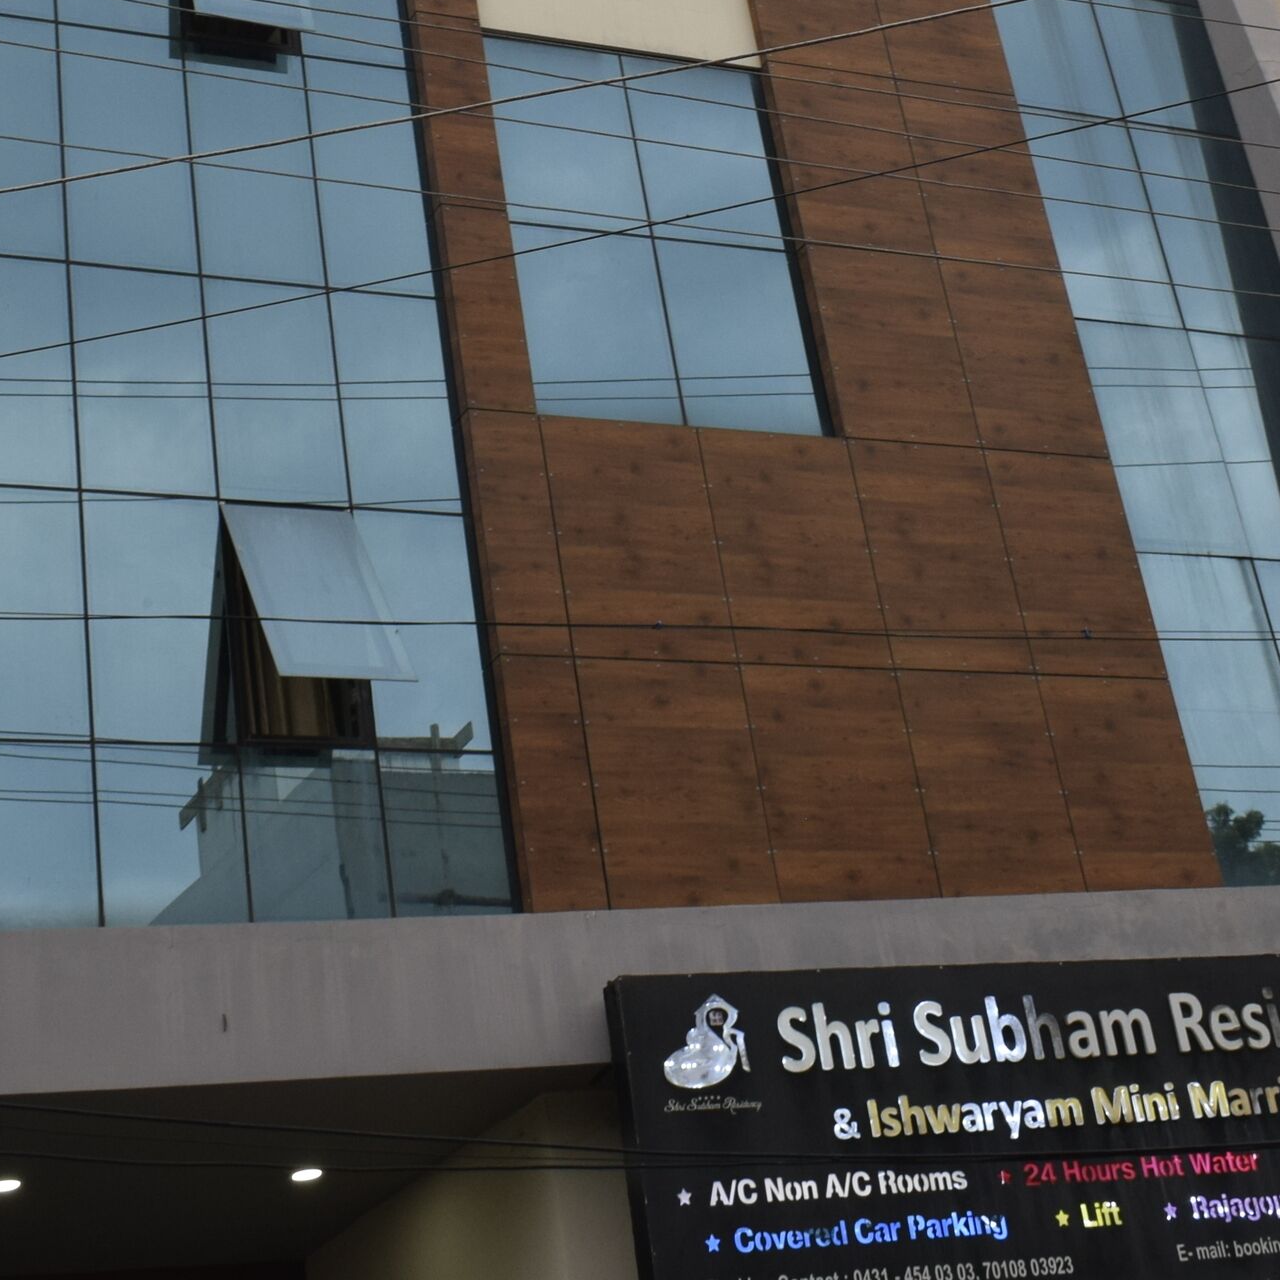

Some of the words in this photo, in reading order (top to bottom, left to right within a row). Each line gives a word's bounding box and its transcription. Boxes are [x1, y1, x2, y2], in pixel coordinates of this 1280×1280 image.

[777, 1001, 900, 1072] Shri
[913, 995, 1156, 1066] Subham
[834, 1108, 861, 1140] &
[867, 1095, 1084, 1139] Ishwaryam
[1091, 1082, 1180, 1125] Mini
[1024, 1163, 1056, 1185] 24
[1063, 1161, 1136, 1181] Hours
[1140, 1155, 1184, 1178] Hot
[1189, 1152, 1258, 1174] Water
[710, 1179, 757, 1206] A/C
[764, 1177, 818, 1202] Non
[826, 1171, 871, 1198] A/C
[878, 1170, 967, 1194] Rooms
[734, 1220, 848, 1253] Covered
[854, 1218, 901, 1244] Car
[907, 1210, 1008, 1240] Parking
[1080, 1201, 1122, 1228] Lift
[904, 1266, 931, 1280] 454
[935, 1264, 953, 1280] 03
[983, 1260, 1026, 1279] 70108
[1031, 1256, 1073, 1276] 03923
